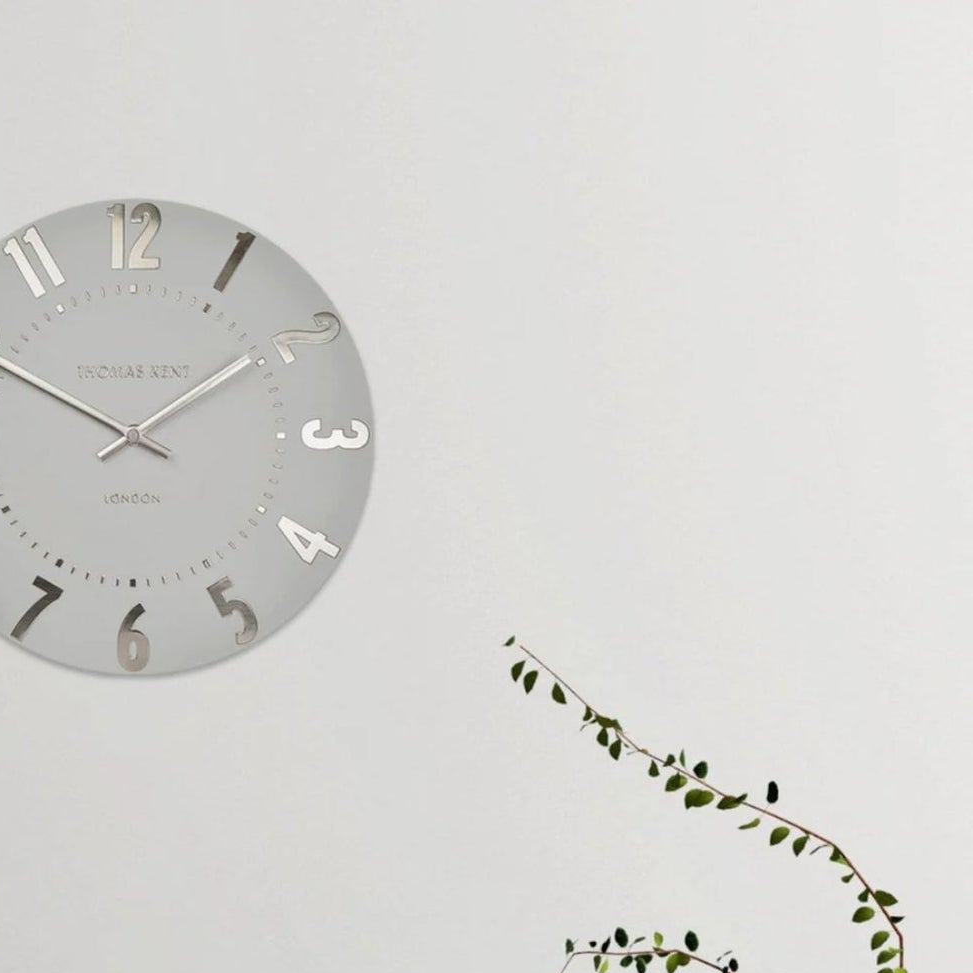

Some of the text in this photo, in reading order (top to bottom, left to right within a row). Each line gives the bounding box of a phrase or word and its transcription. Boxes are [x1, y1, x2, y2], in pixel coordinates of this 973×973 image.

[3, 226, 66, 298] 11
[106, 202, 163, 270] 12
[213, 231, 256, 292] 1
[272, 312, 341, 364] 2
[77, 365, 189, 379] THOMAS KENT
[300, 418, 370, 450] 3
[103, 493, 162, 505] LONDON
[277, 515, 341, 565] 4
[10, 576, 64, 642] 7
[116, 603, 151, 672] 6
[206, 576, 258, 645] 5
